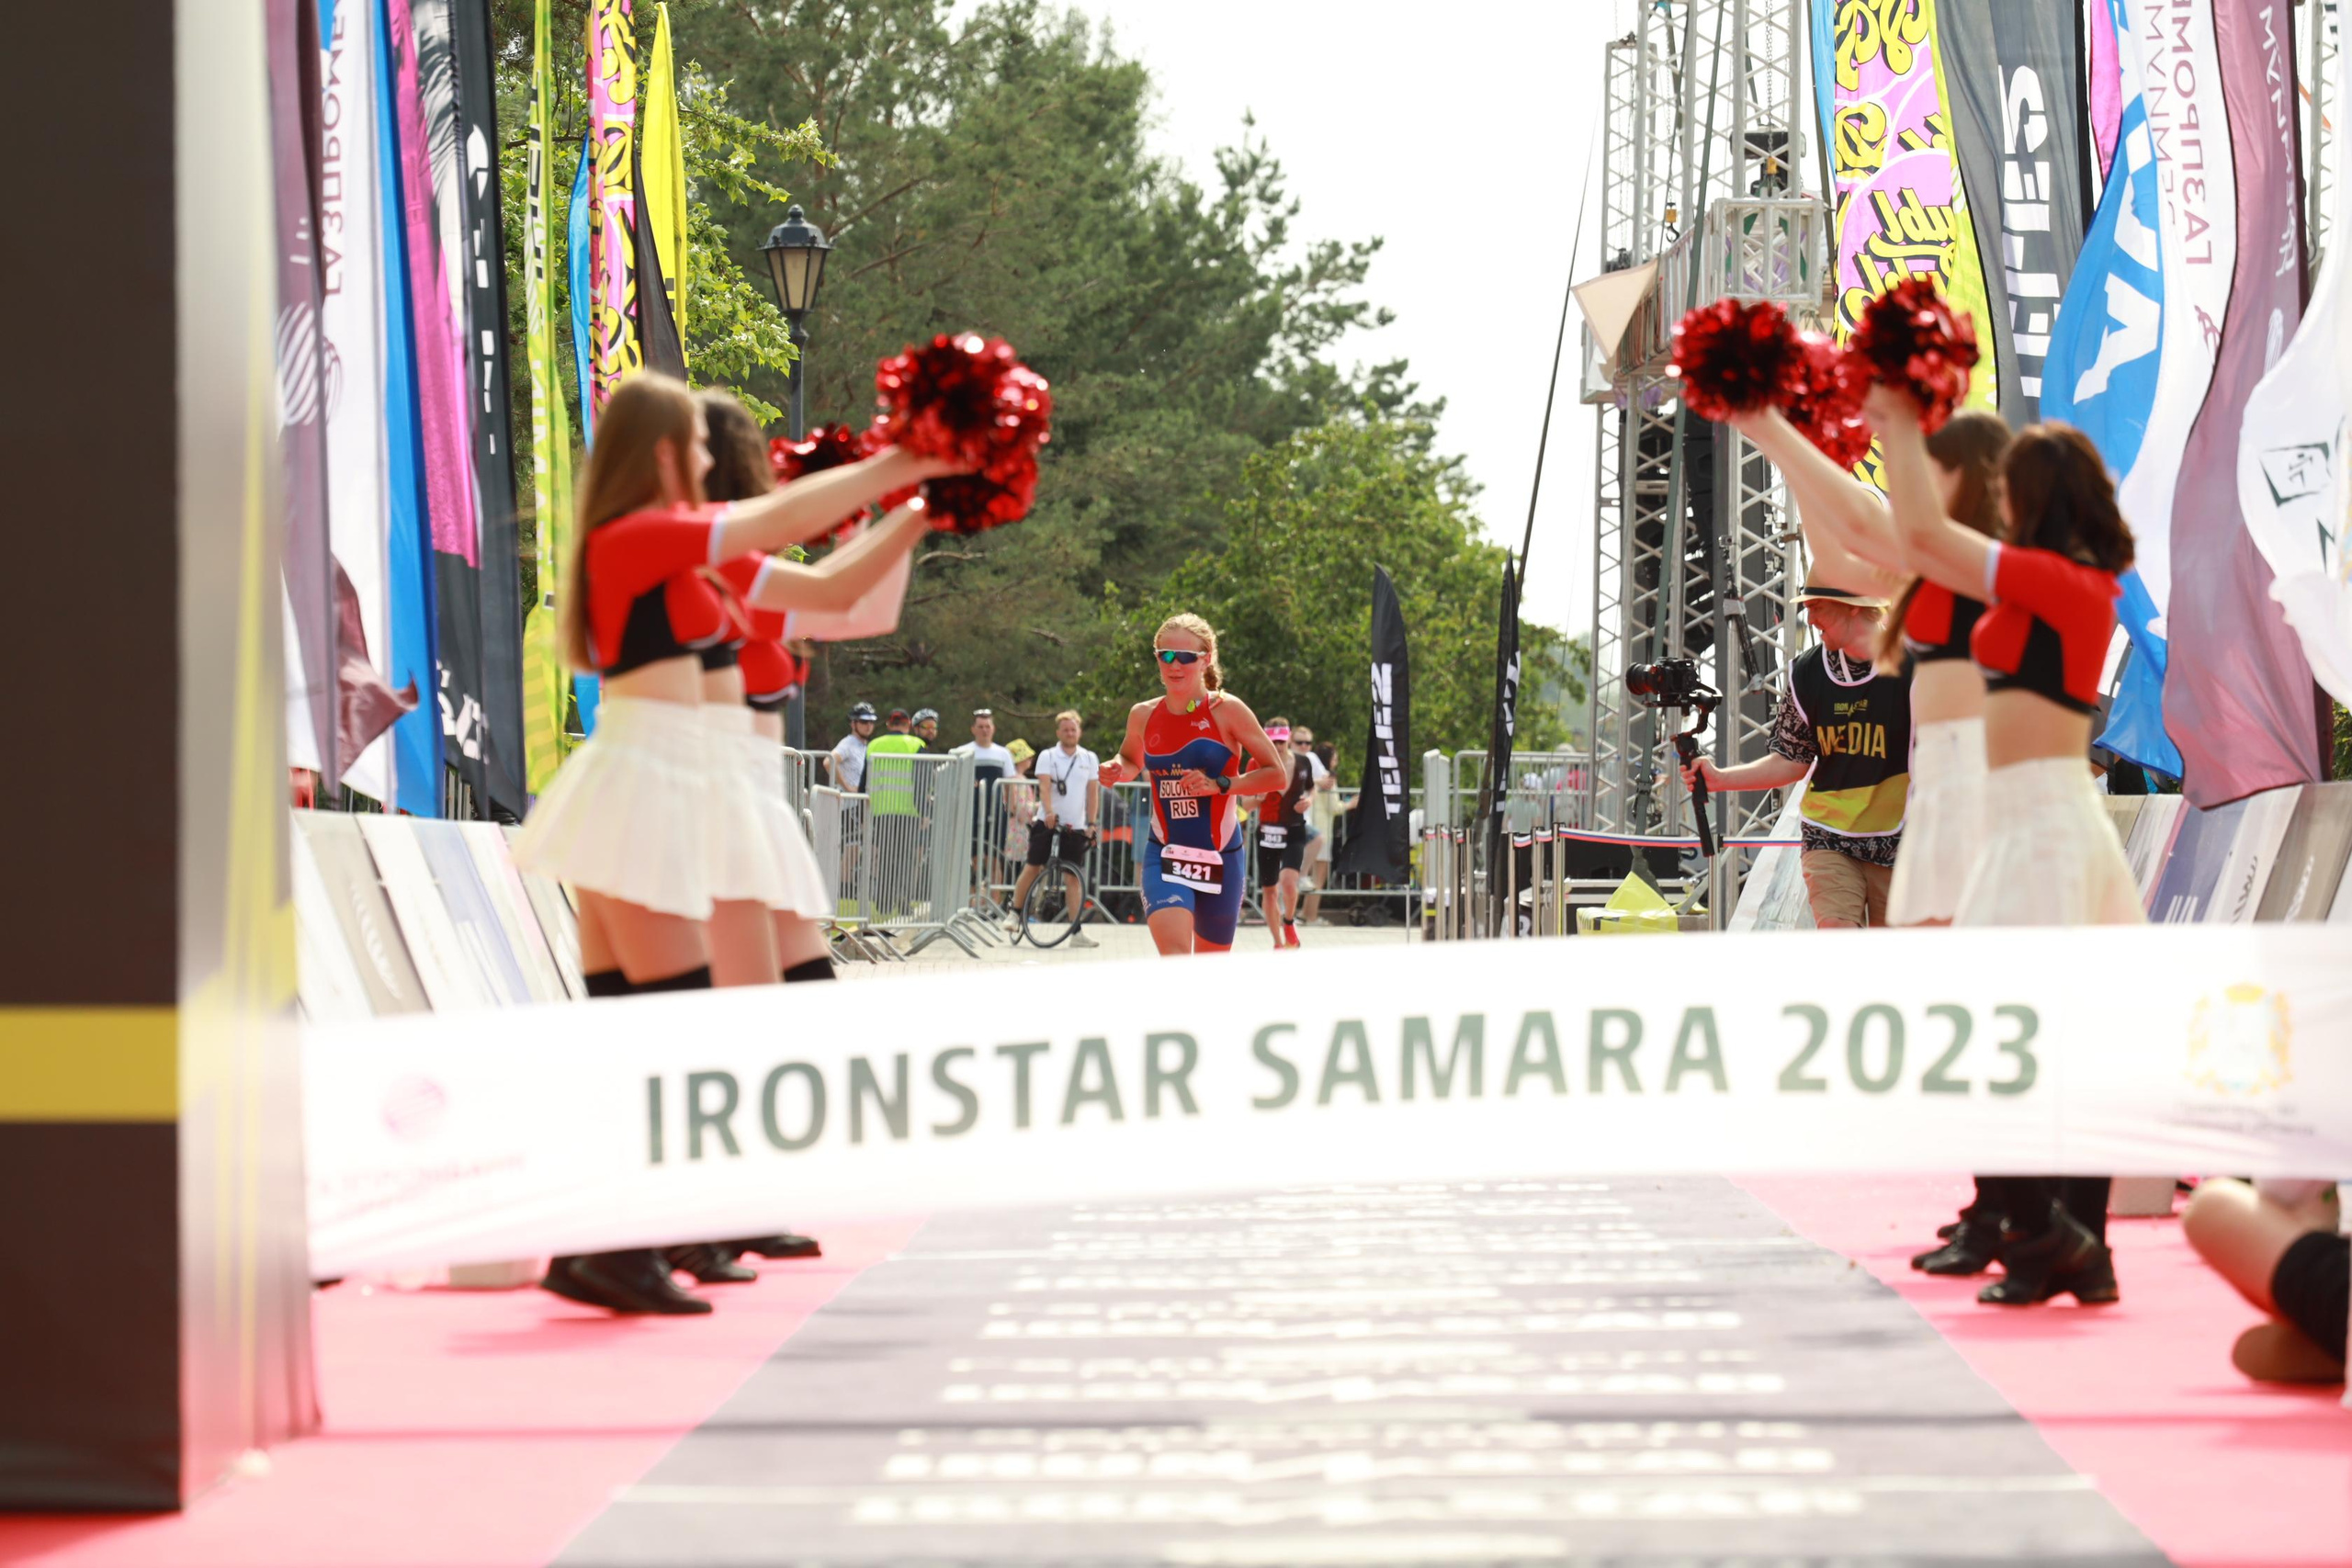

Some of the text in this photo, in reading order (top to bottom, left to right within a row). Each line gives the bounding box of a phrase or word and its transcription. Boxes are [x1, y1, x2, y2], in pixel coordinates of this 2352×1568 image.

[1371, 661, 1402, 820] TELE2
[1816, 722, 1886, 759] MEDIA
[1172, 801, 1197, 817] RUS
[1171, 861, 1212, 881] 3421
[646, 1003, 2040, 1165] IRONSTAR SAMARA 2023
